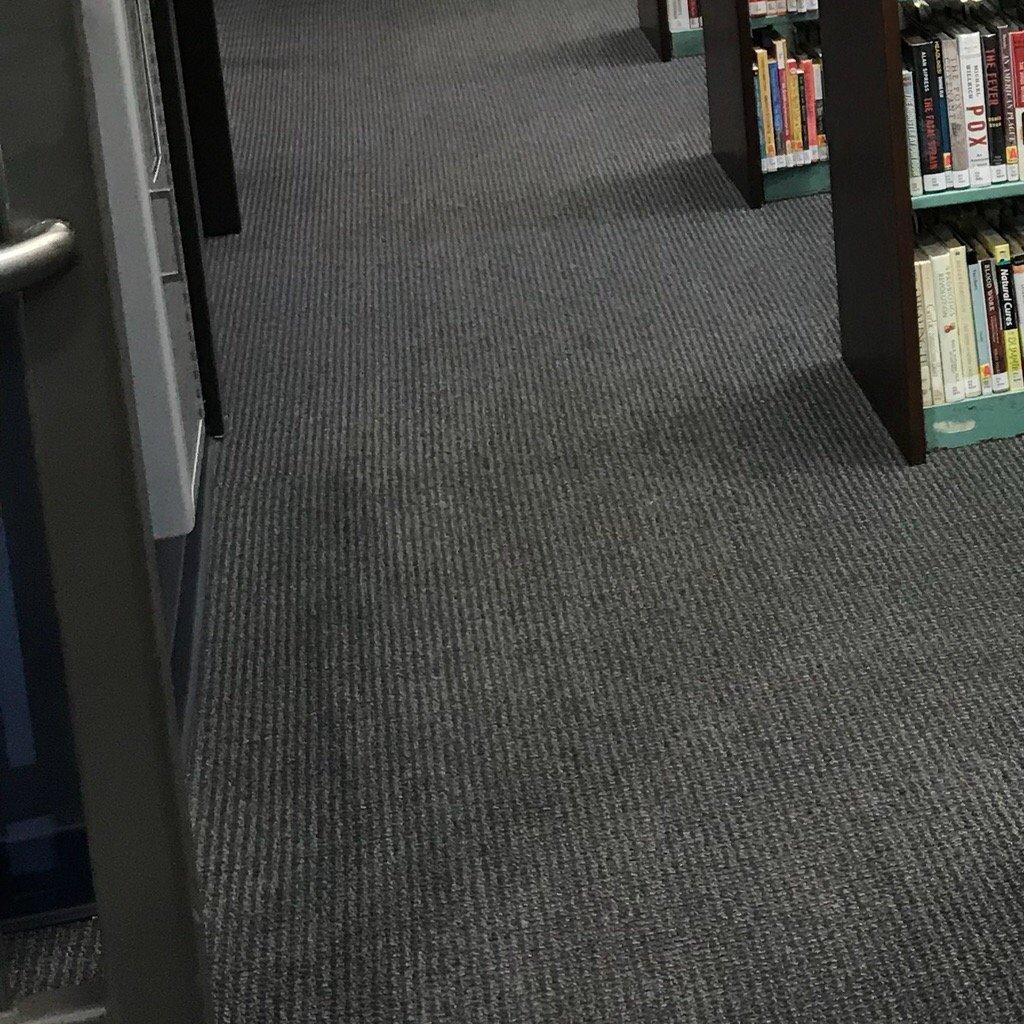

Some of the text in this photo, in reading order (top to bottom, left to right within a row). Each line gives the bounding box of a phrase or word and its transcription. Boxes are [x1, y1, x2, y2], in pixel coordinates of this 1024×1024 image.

[985, 49, 996, 68] THE
[967, 105, 987, 147] POX
[1000, 269, 1013, 326] Natural Cures
